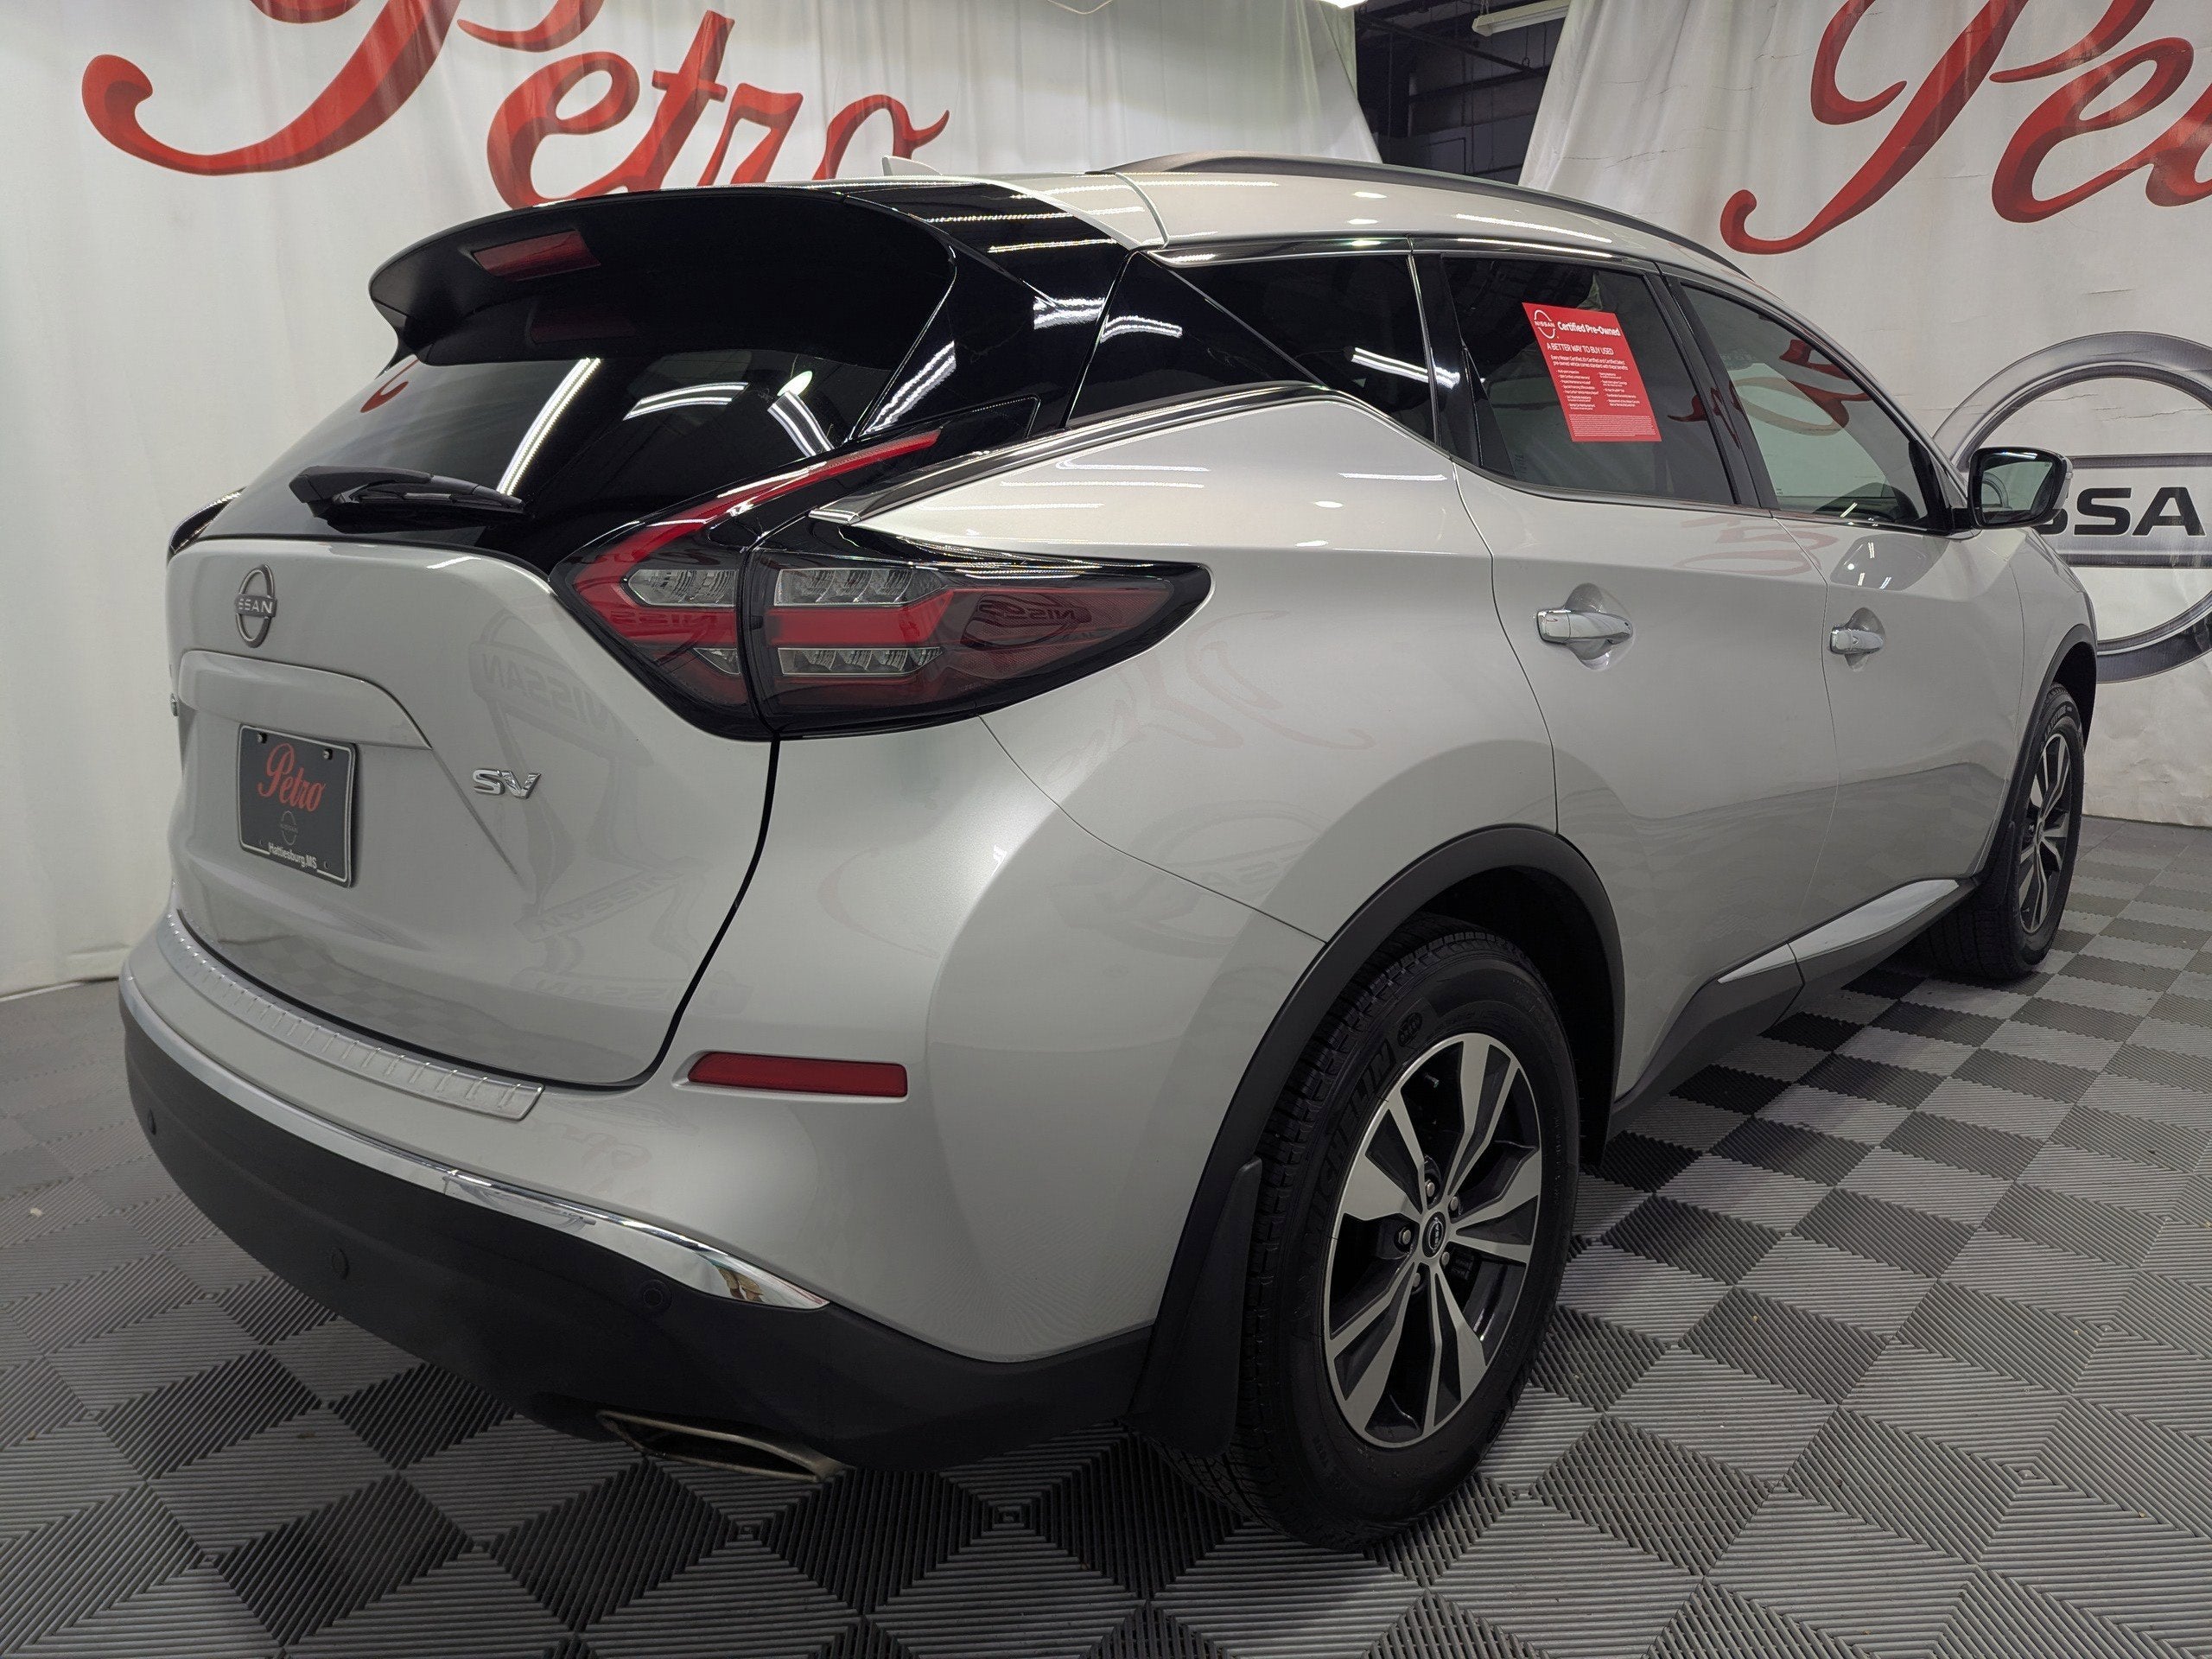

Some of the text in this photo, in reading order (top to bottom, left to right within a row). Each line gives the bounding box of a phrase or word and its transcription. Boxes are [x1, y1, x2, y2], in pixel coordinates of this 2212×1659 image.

[1557, 321, 1621, 336] Certified Pre-Owned
[1551, 342, 1573, 352] BETTER
[1571, 344, 1583, 353] WAY
[1600, 346, 1614, 355] USED
[257, 743, 326, 812] Petro
[473, 768, 542, 799] SV
